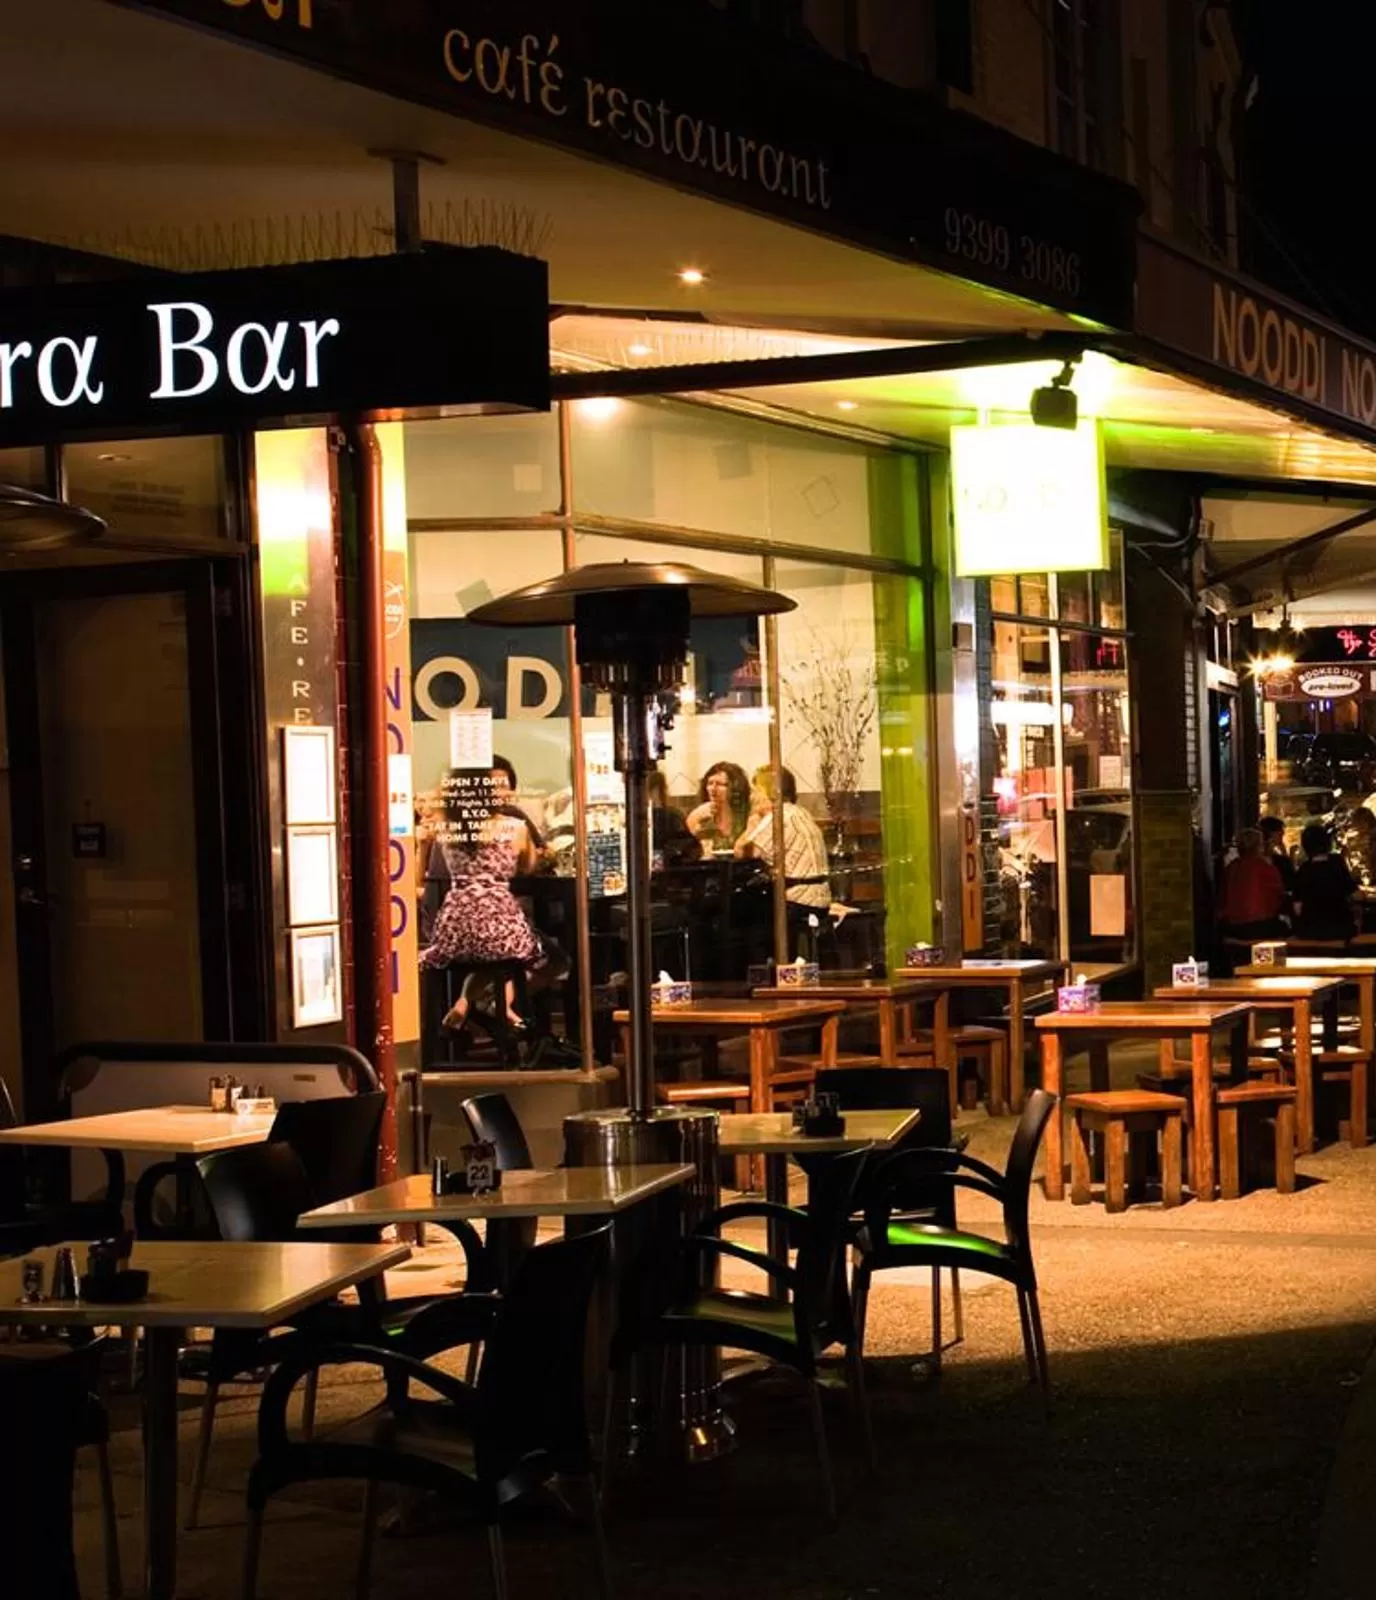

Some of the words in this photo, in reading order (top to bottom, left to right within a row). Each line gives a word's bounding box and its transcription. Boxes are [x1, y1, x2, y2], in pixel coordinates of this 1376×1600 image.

[443, 28, 567, 117] café
[583, 75, 832, 210] restaurant
[944, 207, 1009, 272] 9399
[1020, 235, 1082, 299] 3086
[146, 301, 341, 399] Bar
[1212, 281, 1327, 407] NOODDI
[1337, 629, 1362, 655] The
[1298, 667, 1340, 683] BOOKED
[1342, 667, 1364, 681] OUT
[441, 777, 471, 788] OPEN
[473, 777, 480, 787] 7
[462, 809, 491, 819] B.Y.O.
